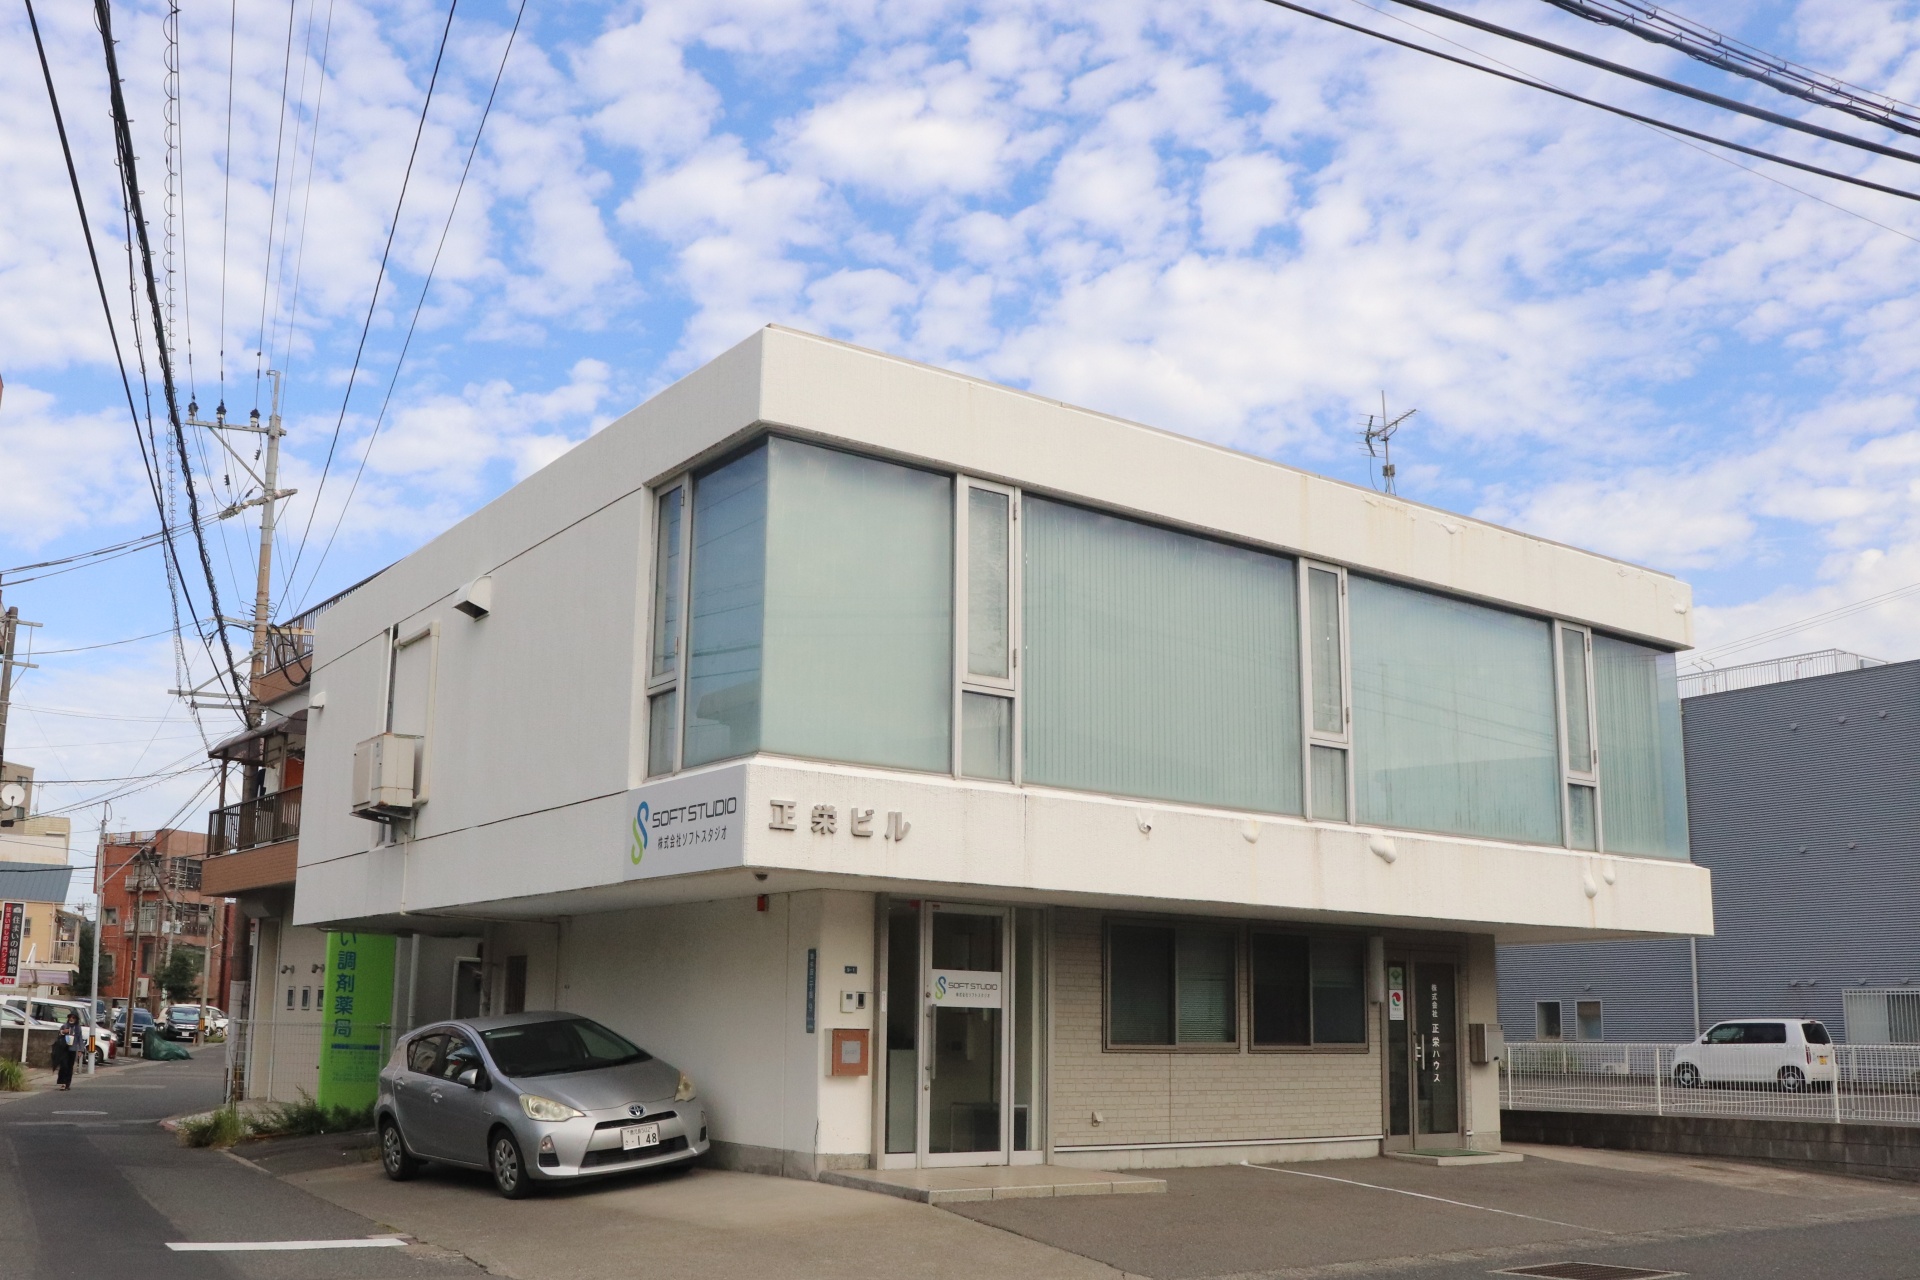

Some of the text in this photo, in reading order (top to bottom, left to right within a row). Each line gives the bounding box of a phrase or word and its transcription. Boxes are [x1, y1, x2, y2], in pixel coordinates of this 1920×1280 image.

[652, 796, 738, 828] SOFT STUDIO
[769, 800, 912, 842] 正栄ビル
[657, 825, 728, 850] 株式会社ソフトスタジオ
[7, 915, 21, 974] 住まいの情報館
[334, 932, 357, 1038] い調剤薬局
[948, 982, 998, 991] SOFT STUDIO
[1431, 1023, 1440, 1082] 正栄ハウス
